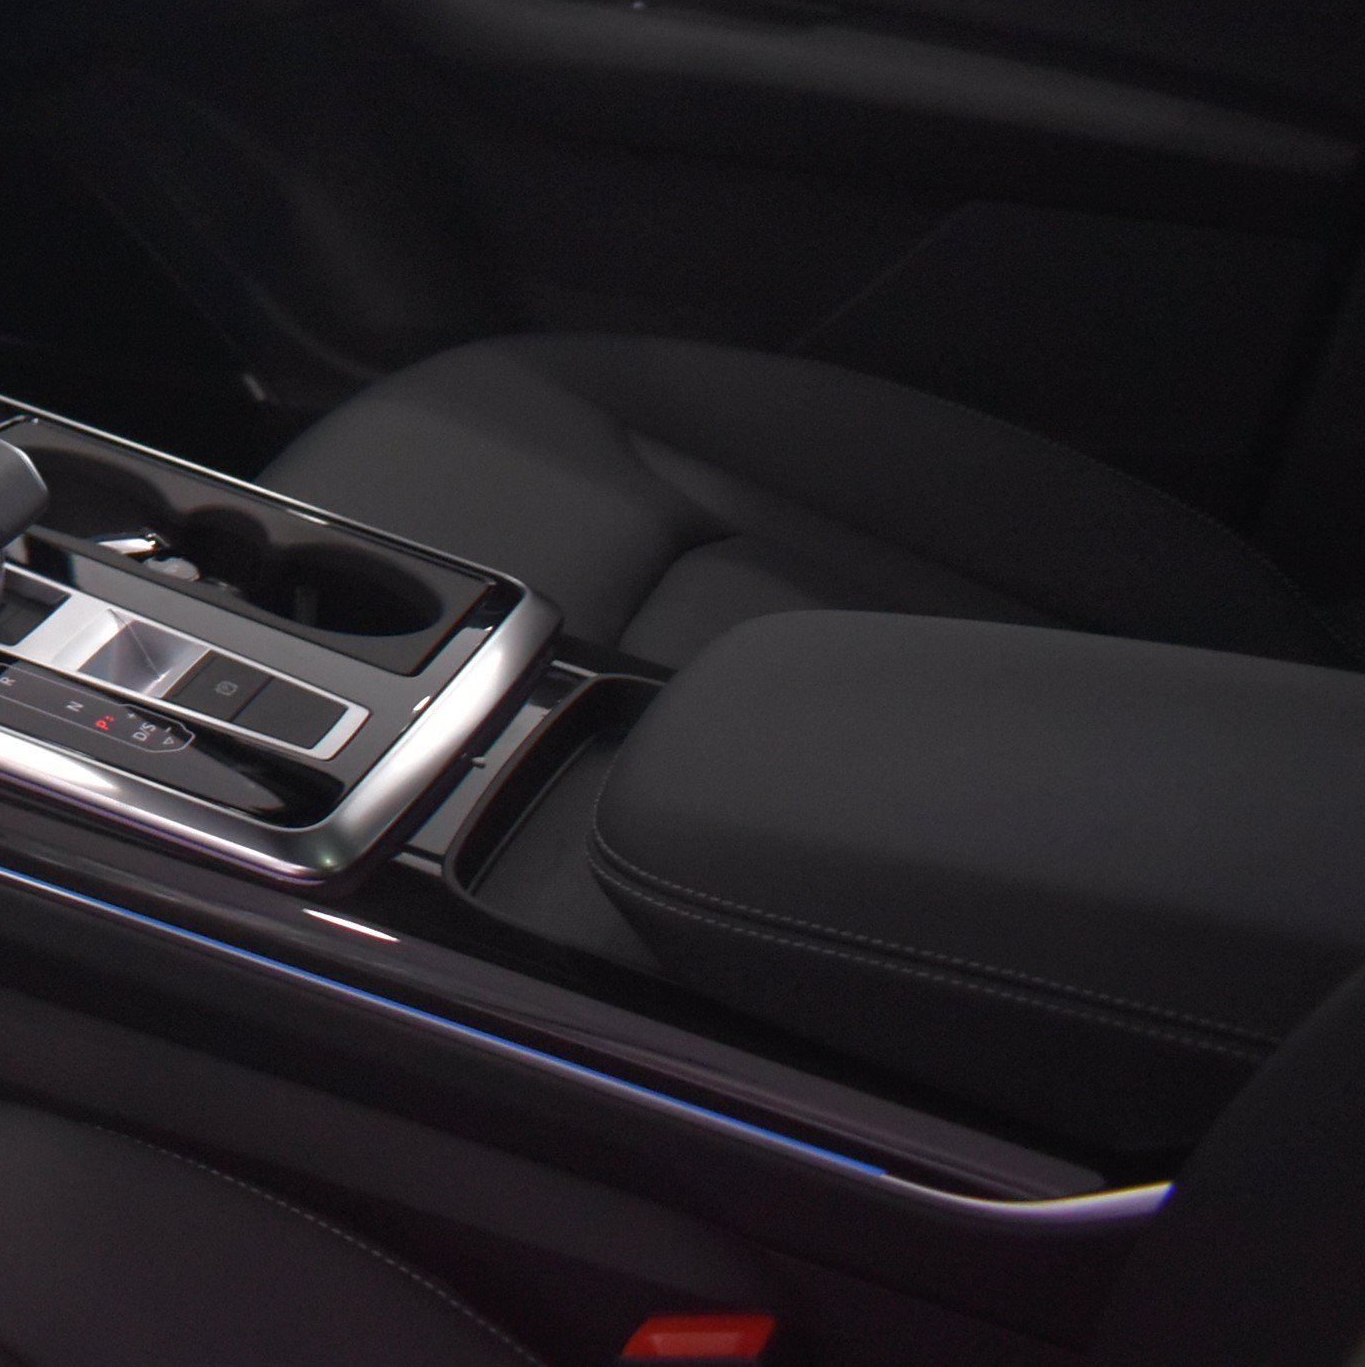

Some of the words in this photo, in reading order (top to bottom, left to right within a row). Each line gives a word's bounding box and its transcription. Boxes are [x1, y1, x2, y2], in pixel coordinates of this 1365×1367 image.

[0, 676, 16, 687] R
[66, 700, 84, 712] N
[132, 721, 157, 742] D/S
